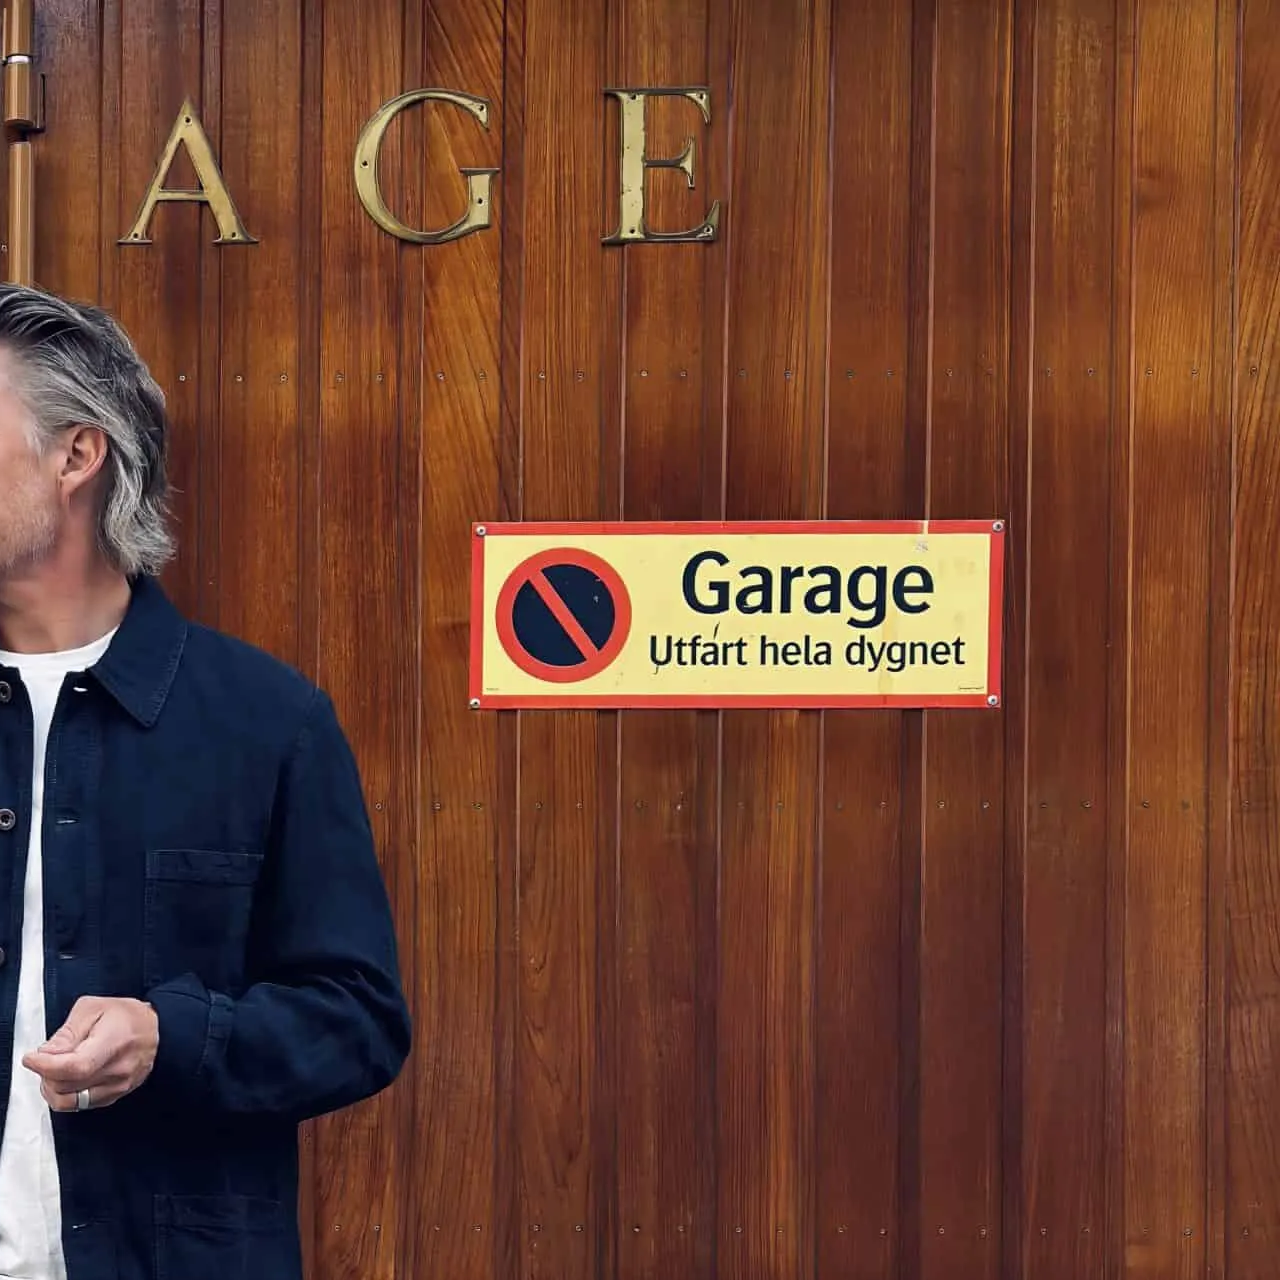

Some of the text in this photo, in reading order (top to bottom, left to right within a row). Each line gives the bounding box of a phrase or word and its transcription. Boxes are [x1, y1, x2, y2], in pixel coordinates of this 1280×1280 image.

[682, 550, 934, 628] Garage
[650, 634, 966, 673] Utfart hela dygnet
